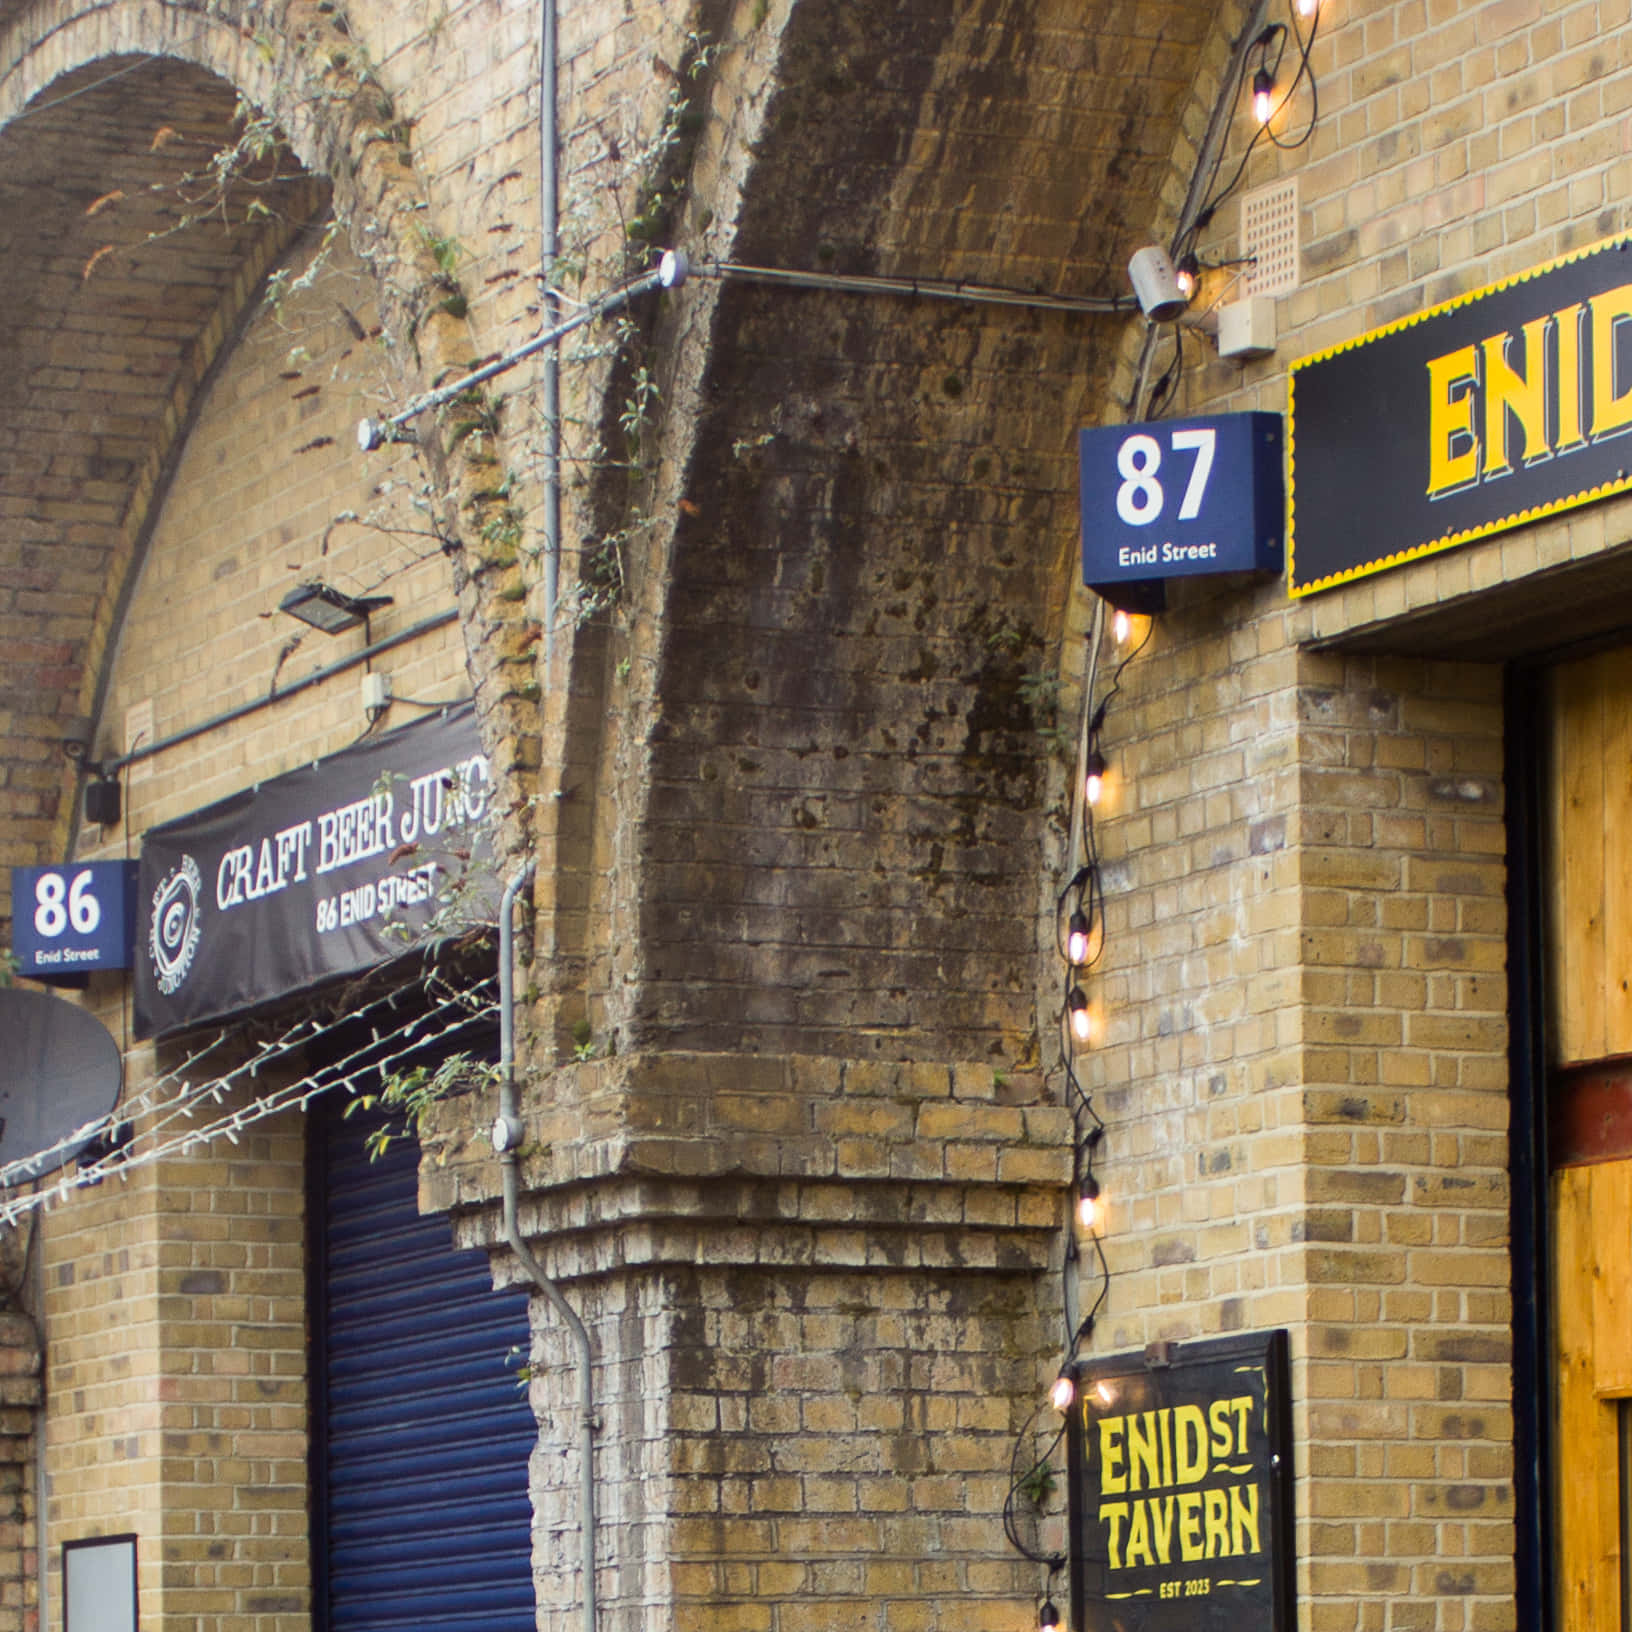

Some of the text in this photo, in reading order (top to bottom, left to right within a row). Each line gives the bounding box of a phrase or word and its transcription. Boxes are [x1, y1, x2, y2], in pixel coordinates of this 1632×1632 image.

[1116, 428, 1216, 526] 87
[1118, 542, 1217, 567] Enid Street
[216, 820, 312, 912] CRAFT
[316, 791, 396, 875] BEER
[34, 869, 100, 937] 86
[317, 862, 437, 933] 86 ENID STREET
[35, 947, 100, 965] Enid Street
[1099, 1483, 1261, 1570] TAVERN
[1159, 1578, 1211, 1599] EST 2023
